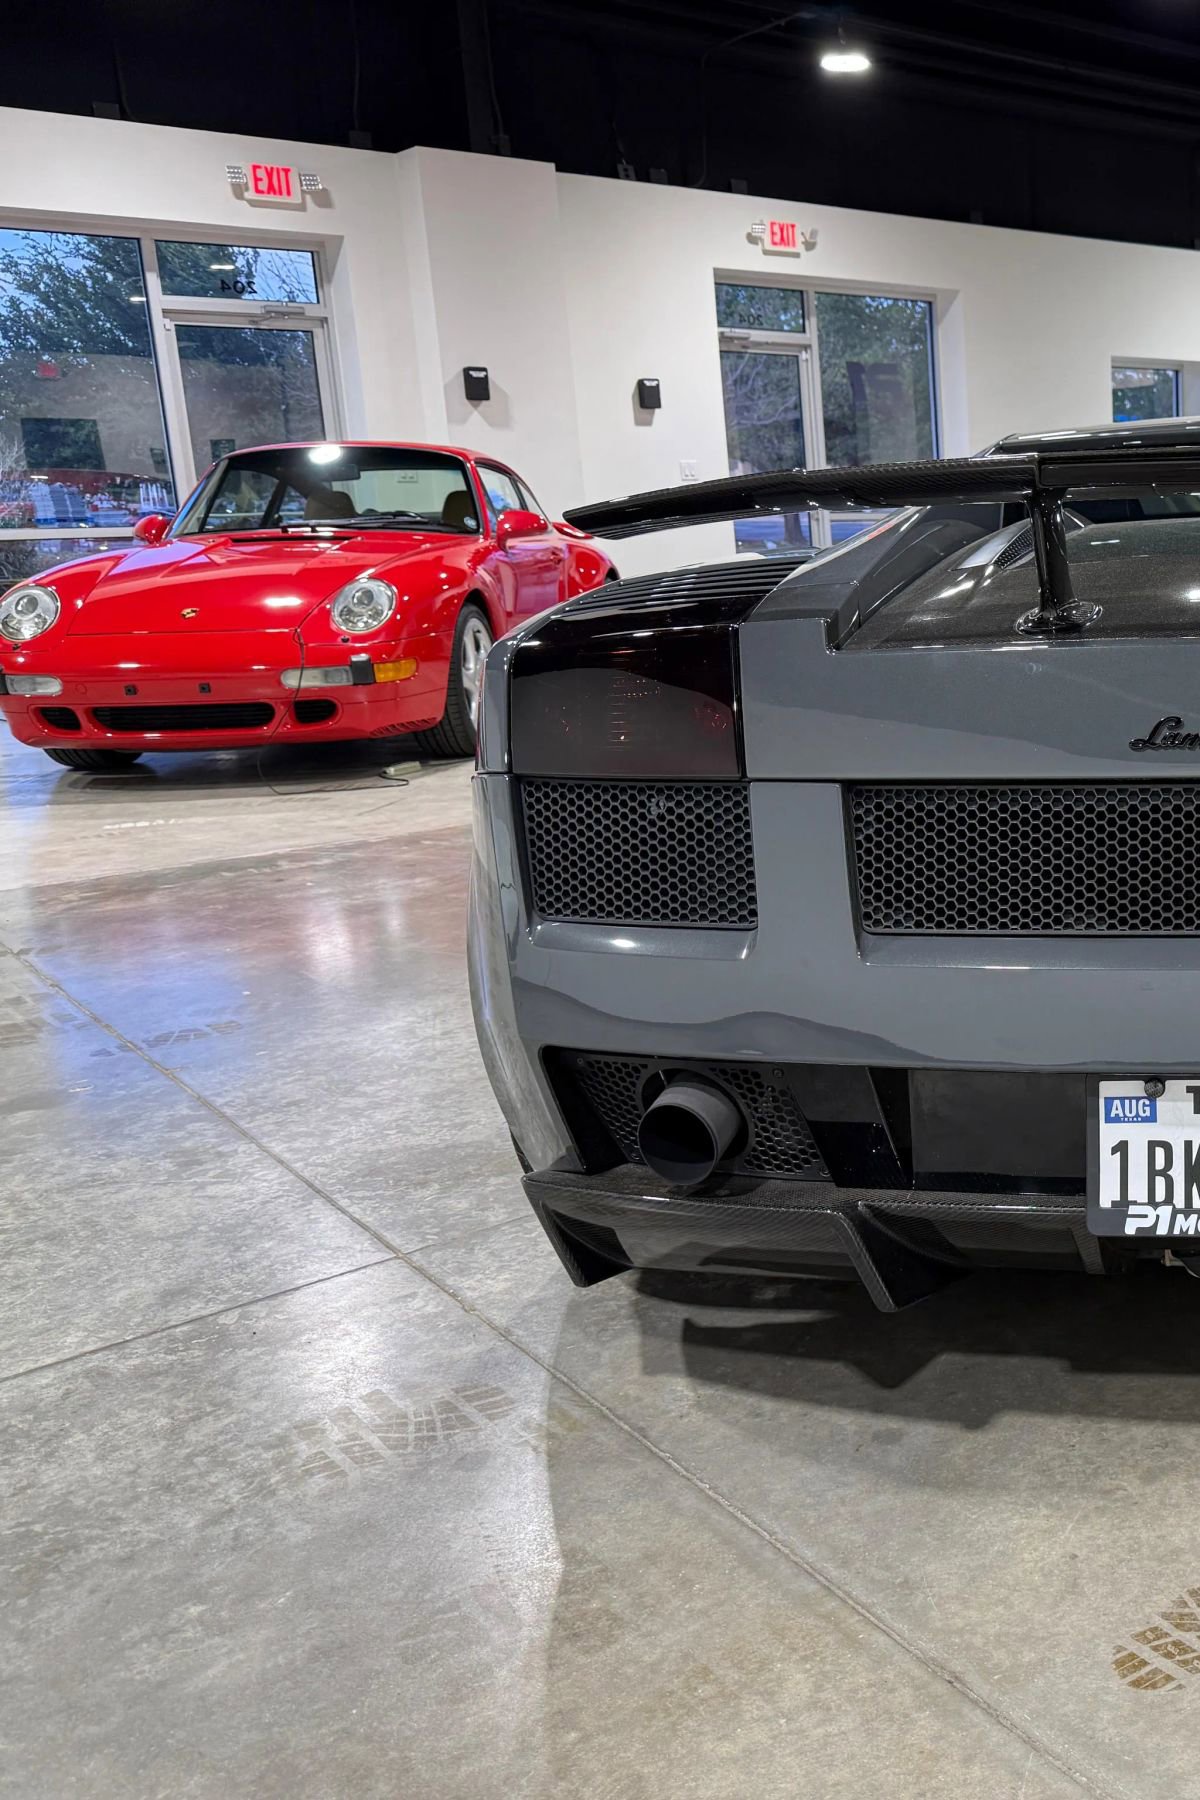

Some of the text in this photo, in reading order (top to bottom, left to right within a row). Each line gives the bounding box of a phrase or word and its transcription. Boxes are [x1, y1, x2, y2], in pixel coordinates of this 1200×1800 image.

[251, 164, 292, 197] EXIT
[769, 221, 797, 248] EXIT
[1110, 1098, 1151, 1117] AUG
[1124, 1205, 1173, 1236] P1
